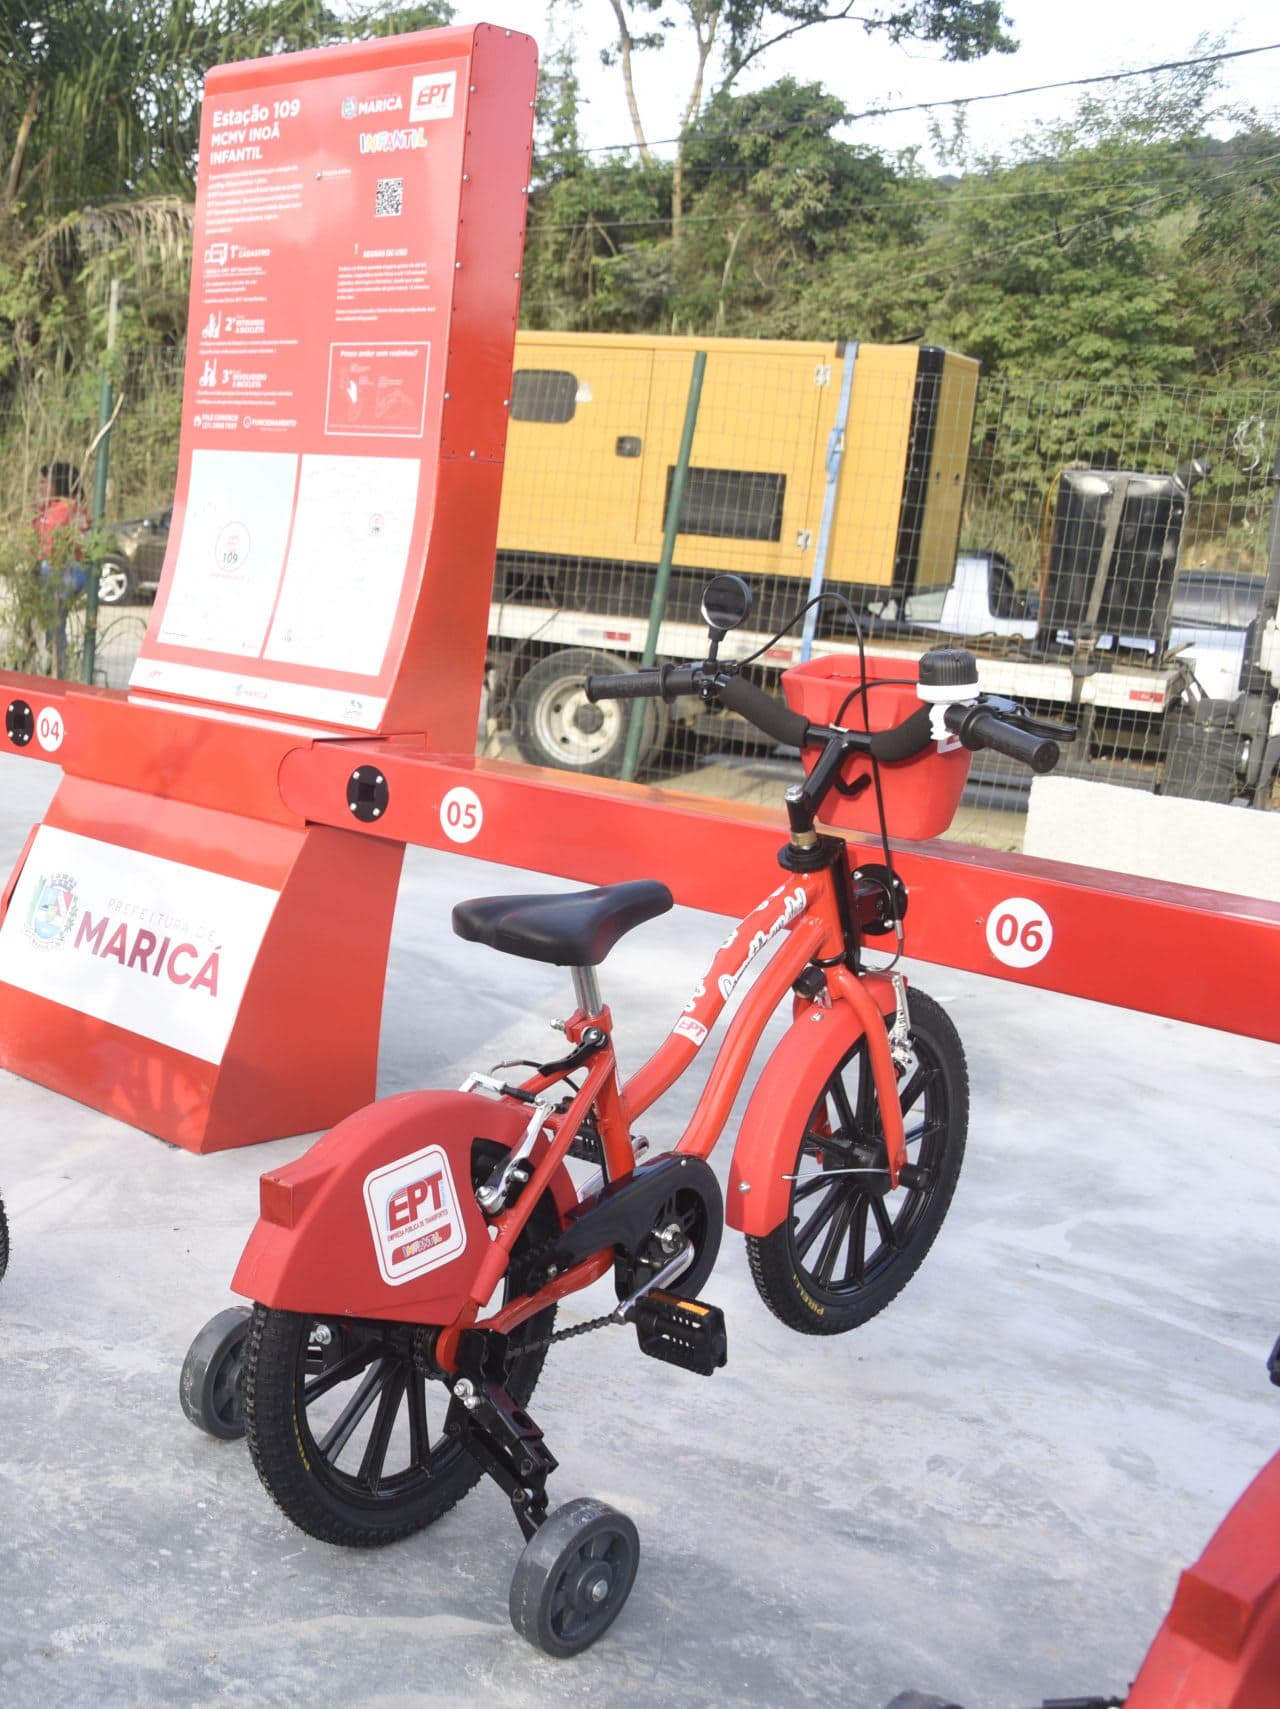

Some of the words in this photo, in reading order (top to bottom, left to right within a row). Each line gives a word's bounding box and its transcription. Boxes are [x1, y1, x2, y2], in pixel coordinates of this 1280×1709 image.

[415, 82, 452, 107] EPT
[212, 103, 269, 128] Estação
[273, 98, 300, 119] 109
[210, 130, 246, 147] MCMV
[359, 127, 428, 154] INFANTIL
[209, 146, 263, 165] INFANTIL
[40, 719, 60, 740] 04
[447, 800, 477, 829] 05
[107, 897, 189, 934] PREFEITURA
[196, 927, 218, 944] DE
[995, 913, 1043, 952] 06
[73, 910, 222, 997] MARICÁ
[388, 1171, 443, 1231] EPT
[402, 1231, 443, 1257] INFANTIL
